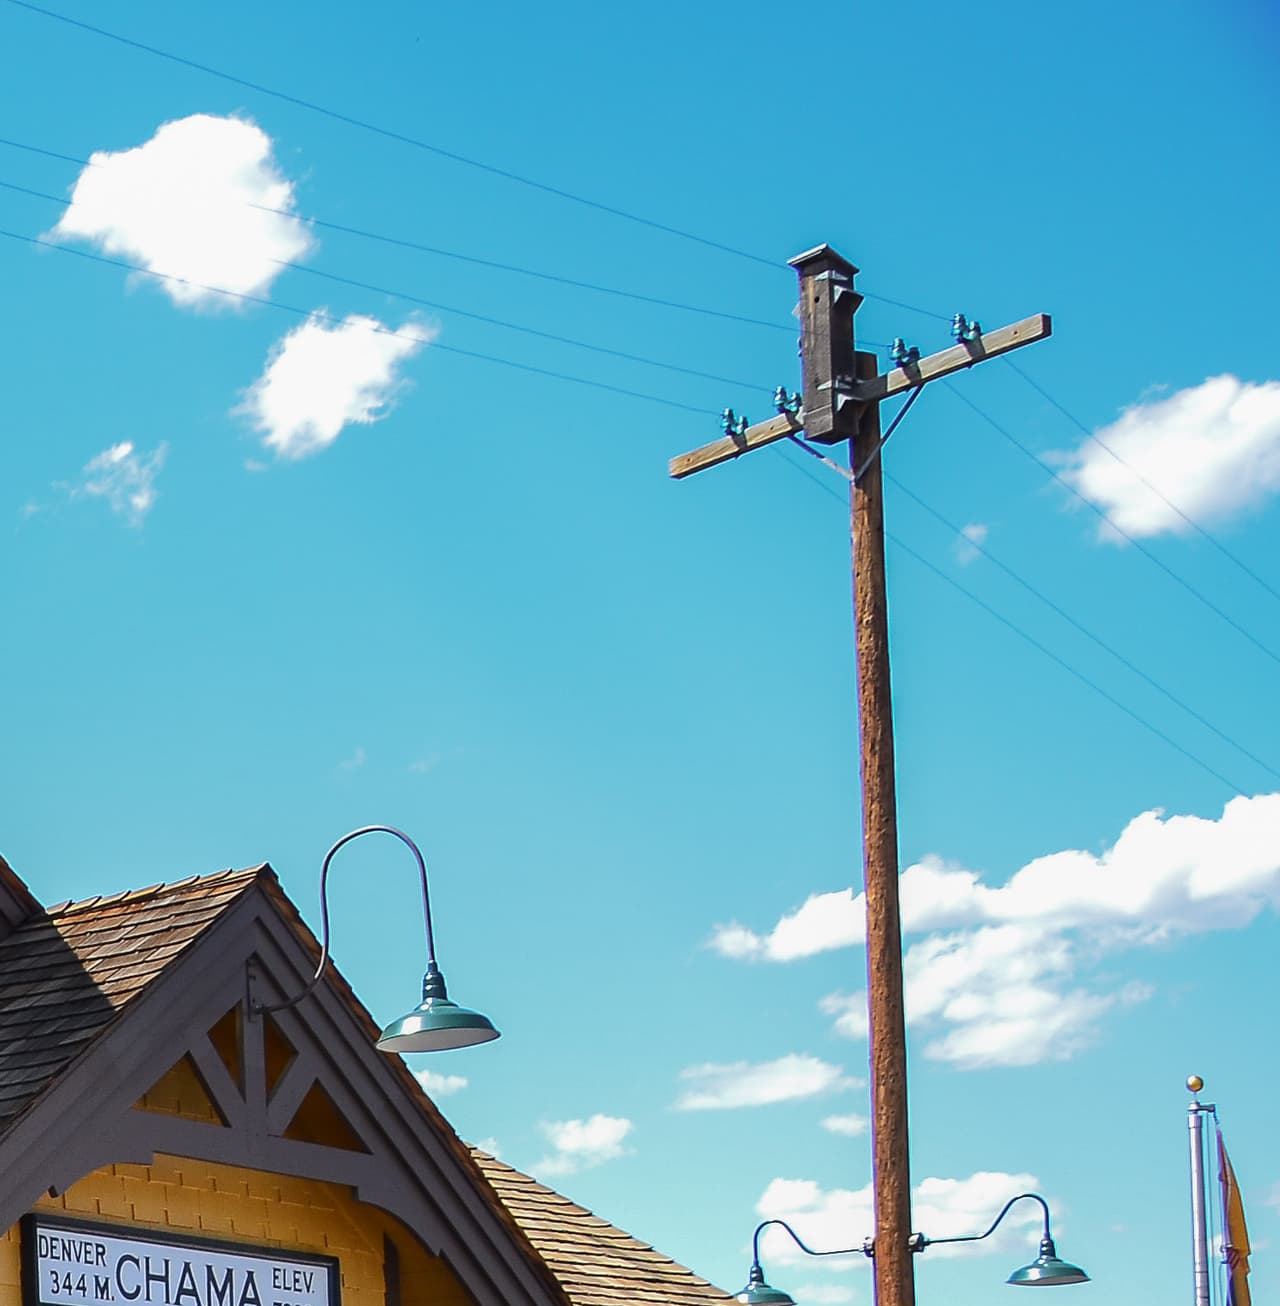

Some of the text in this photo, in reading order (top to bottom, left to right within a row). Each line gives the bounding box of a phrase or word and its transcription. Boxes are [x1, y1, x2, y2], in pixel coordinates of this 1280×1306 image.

[38, 1235, 107, 1267] DENVER
[50, 1271, 115, 1301] 344 M.
[272, 1268, 316, 1294] ELEV.
